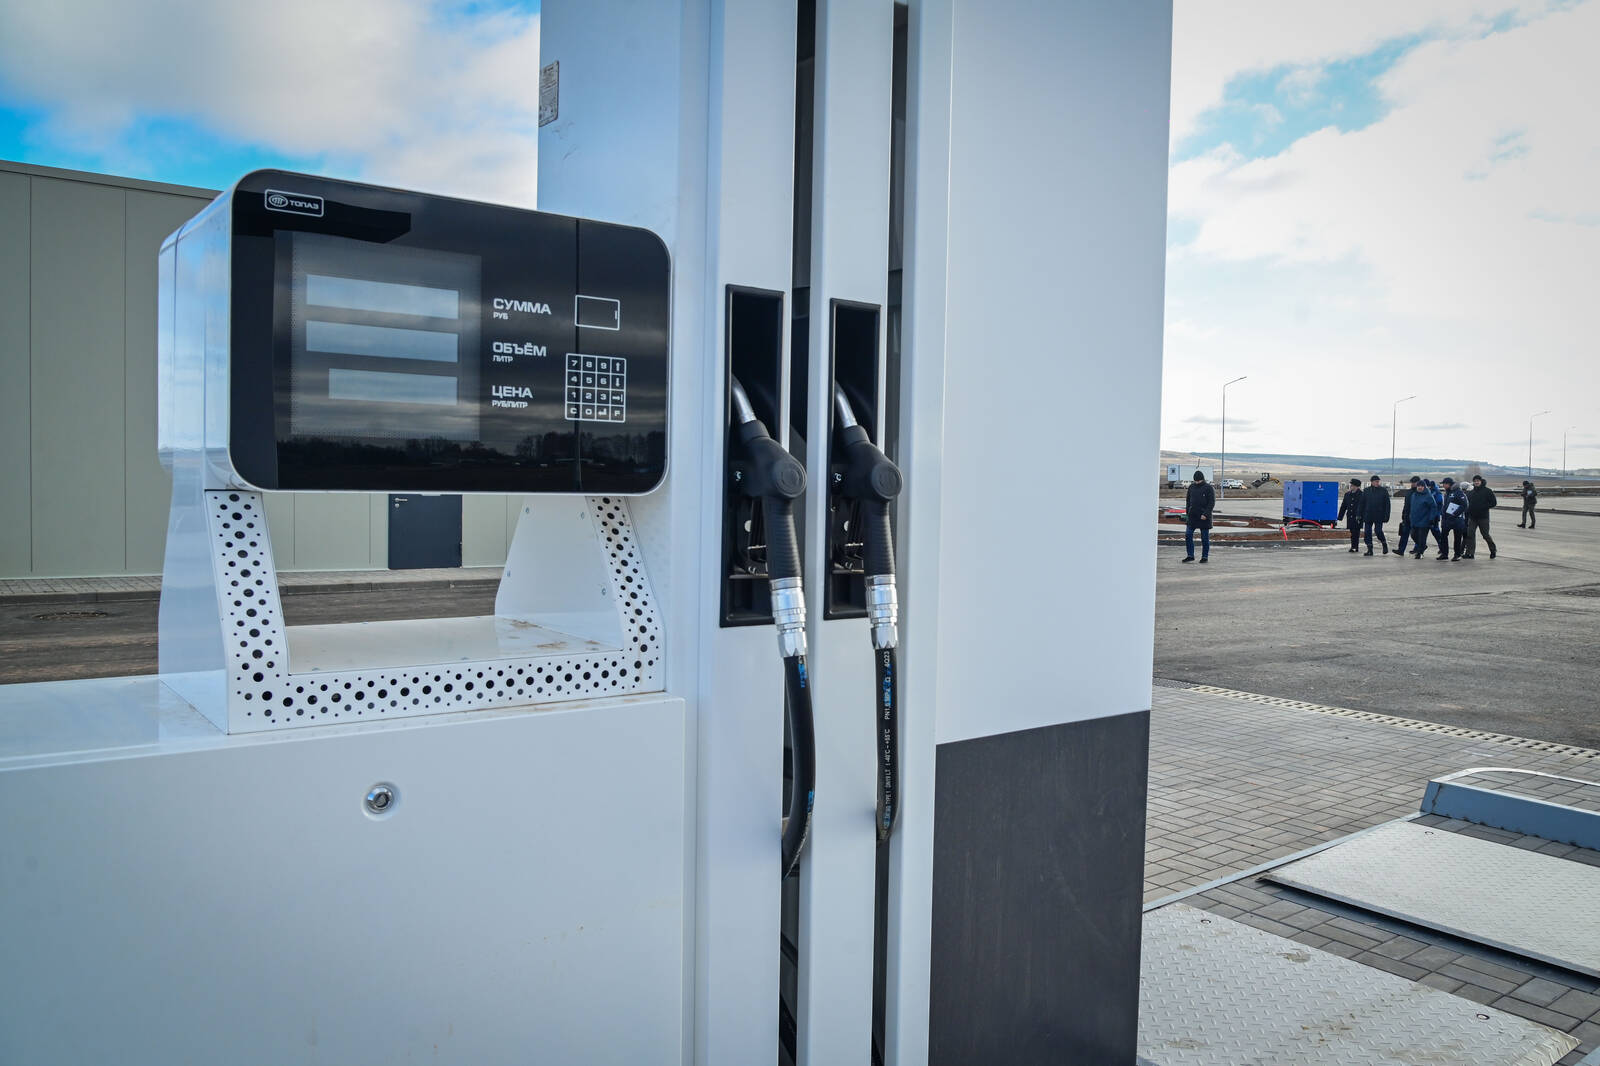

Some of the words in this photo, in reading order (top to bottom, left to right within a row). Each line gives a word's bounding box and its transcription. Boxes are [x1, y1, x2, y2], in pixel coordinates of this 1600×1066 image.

[289, 199, 319, 210] ТОПАЗ
[493, 298, 552, 315] СУММА
[493, 311, 509, 320] РУБ
[492, 341, 547, 357] ОБЪЁМ
[492, 355, 514, 363] ЛИТР
[600, 362, 607, 370] 9
[491, 384, 533, 399] ЦЕНА
[585, 392, 592, 400] 2
